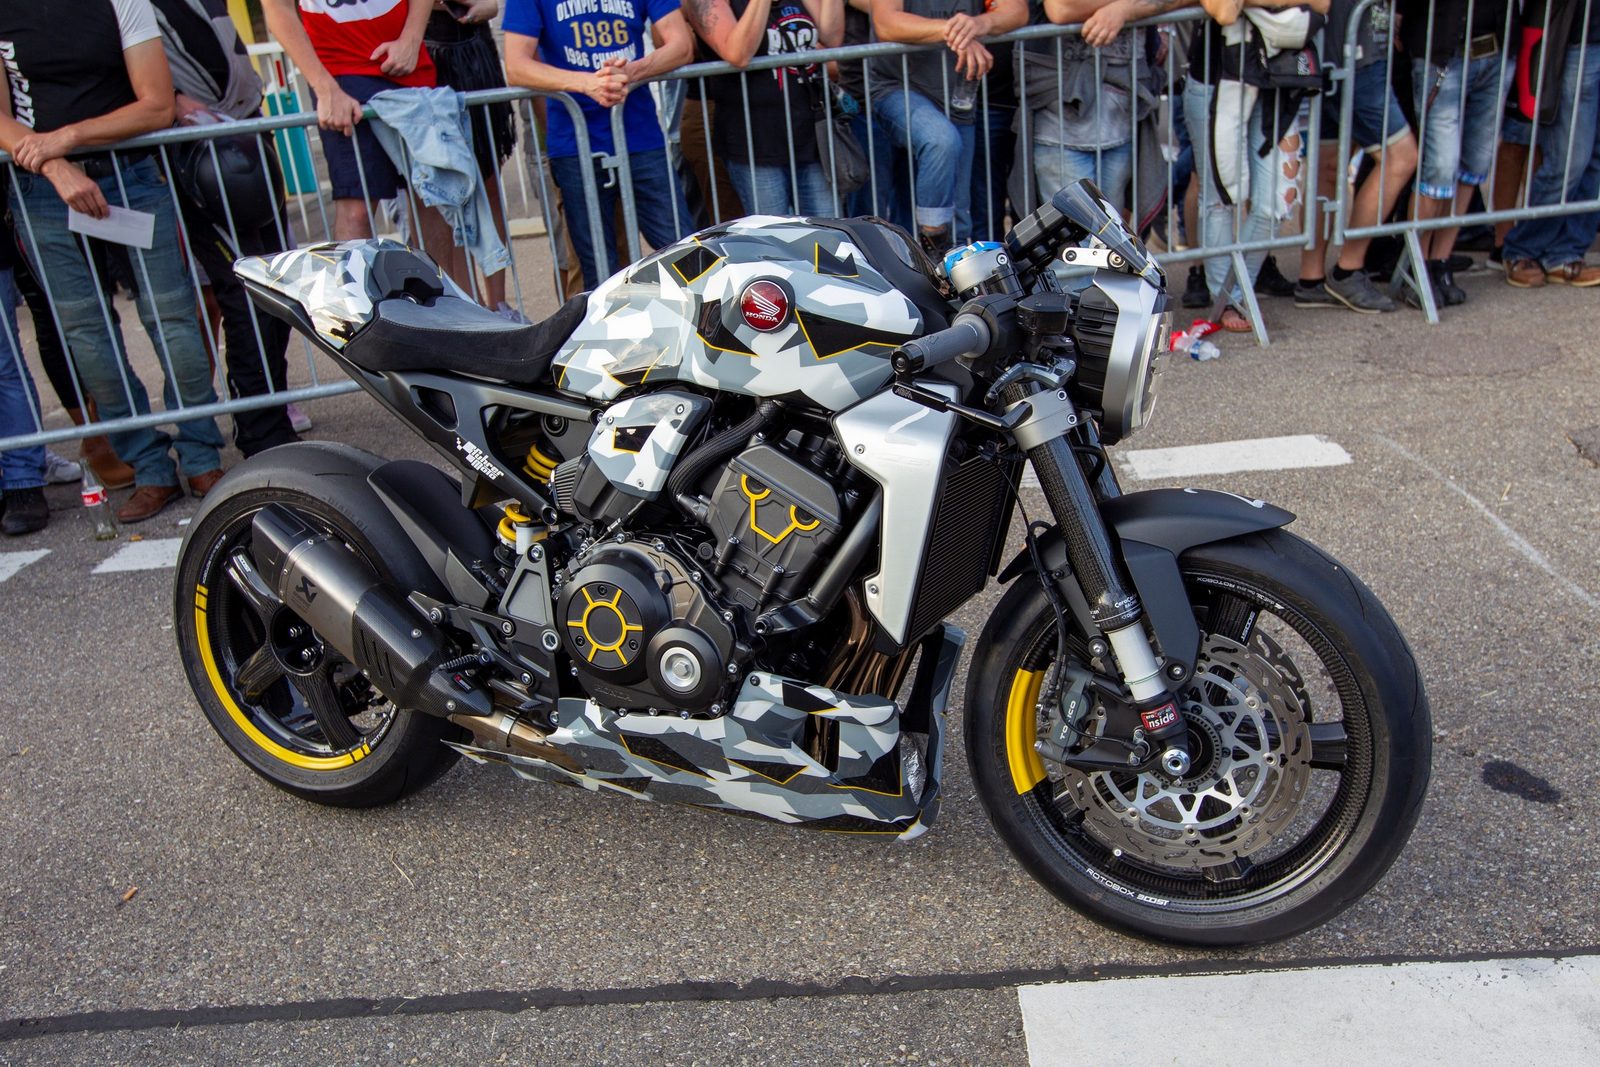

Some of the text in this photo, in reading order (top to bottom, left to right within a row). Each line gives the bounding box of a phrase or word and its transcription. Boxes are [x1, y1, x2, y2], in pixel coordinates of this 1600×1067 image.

[556, 0, 635, 21] OLYMPIC GAMES
[570, 20, 628, 48] 1986
[564, 46, 590, 67] 1986
[745, 311, 779, 322] HONDA
[1060, 700, 1077, 740] TOICO
[1086, 868, 1170, 906] ROTOBOX BOOST
